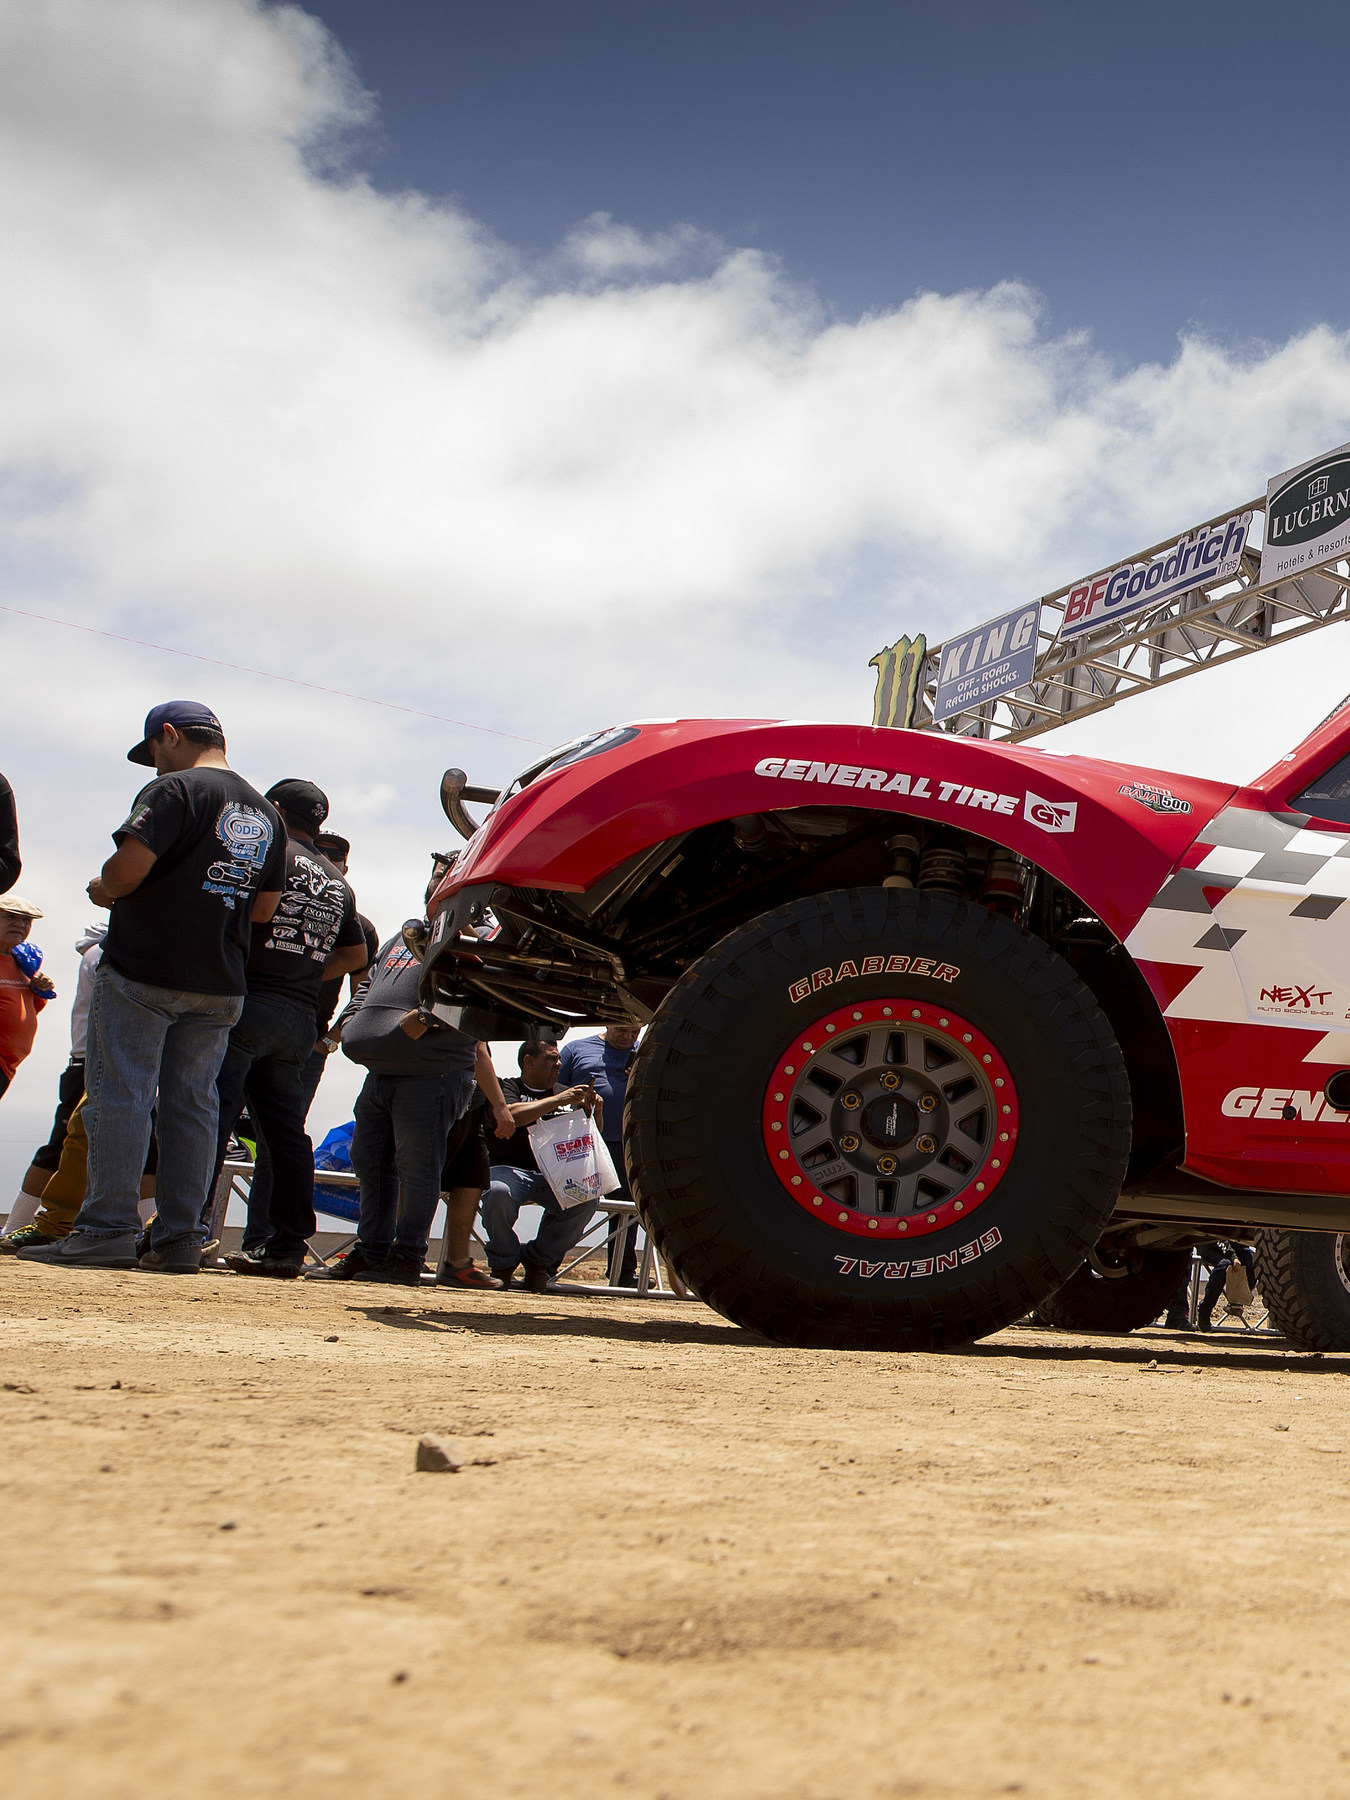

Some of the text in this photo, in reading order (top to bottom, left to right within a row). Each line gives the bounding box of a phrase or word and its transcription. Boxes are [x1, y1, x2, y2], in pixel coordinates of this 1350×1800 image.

[1064, 521, 1245, 624] BFGoodrich
[1217, 558, 1238, 574] Tires
[1277, 554, 1305, 573] Hotels
[1307, 548, 1314, 560] &
[941, 611, 1036, 684] KING
[945, 670, 1018, 709] RACING SHOCKS
[957, 677, 975, 692] OFF
[982, 662, 1010, 682] ROAD
[754, 757, 1071, 829] GENERAL TIRE GT
[1120, 785, 1191, 813] BAJA 500
[788, 955, 960, 1003] GRABBER
[1260, 985, 1332, 1008] NEXT
[555, 1136, 594, 1155] SCOR
[834, 1227, 1003, 1279] GENERAL
